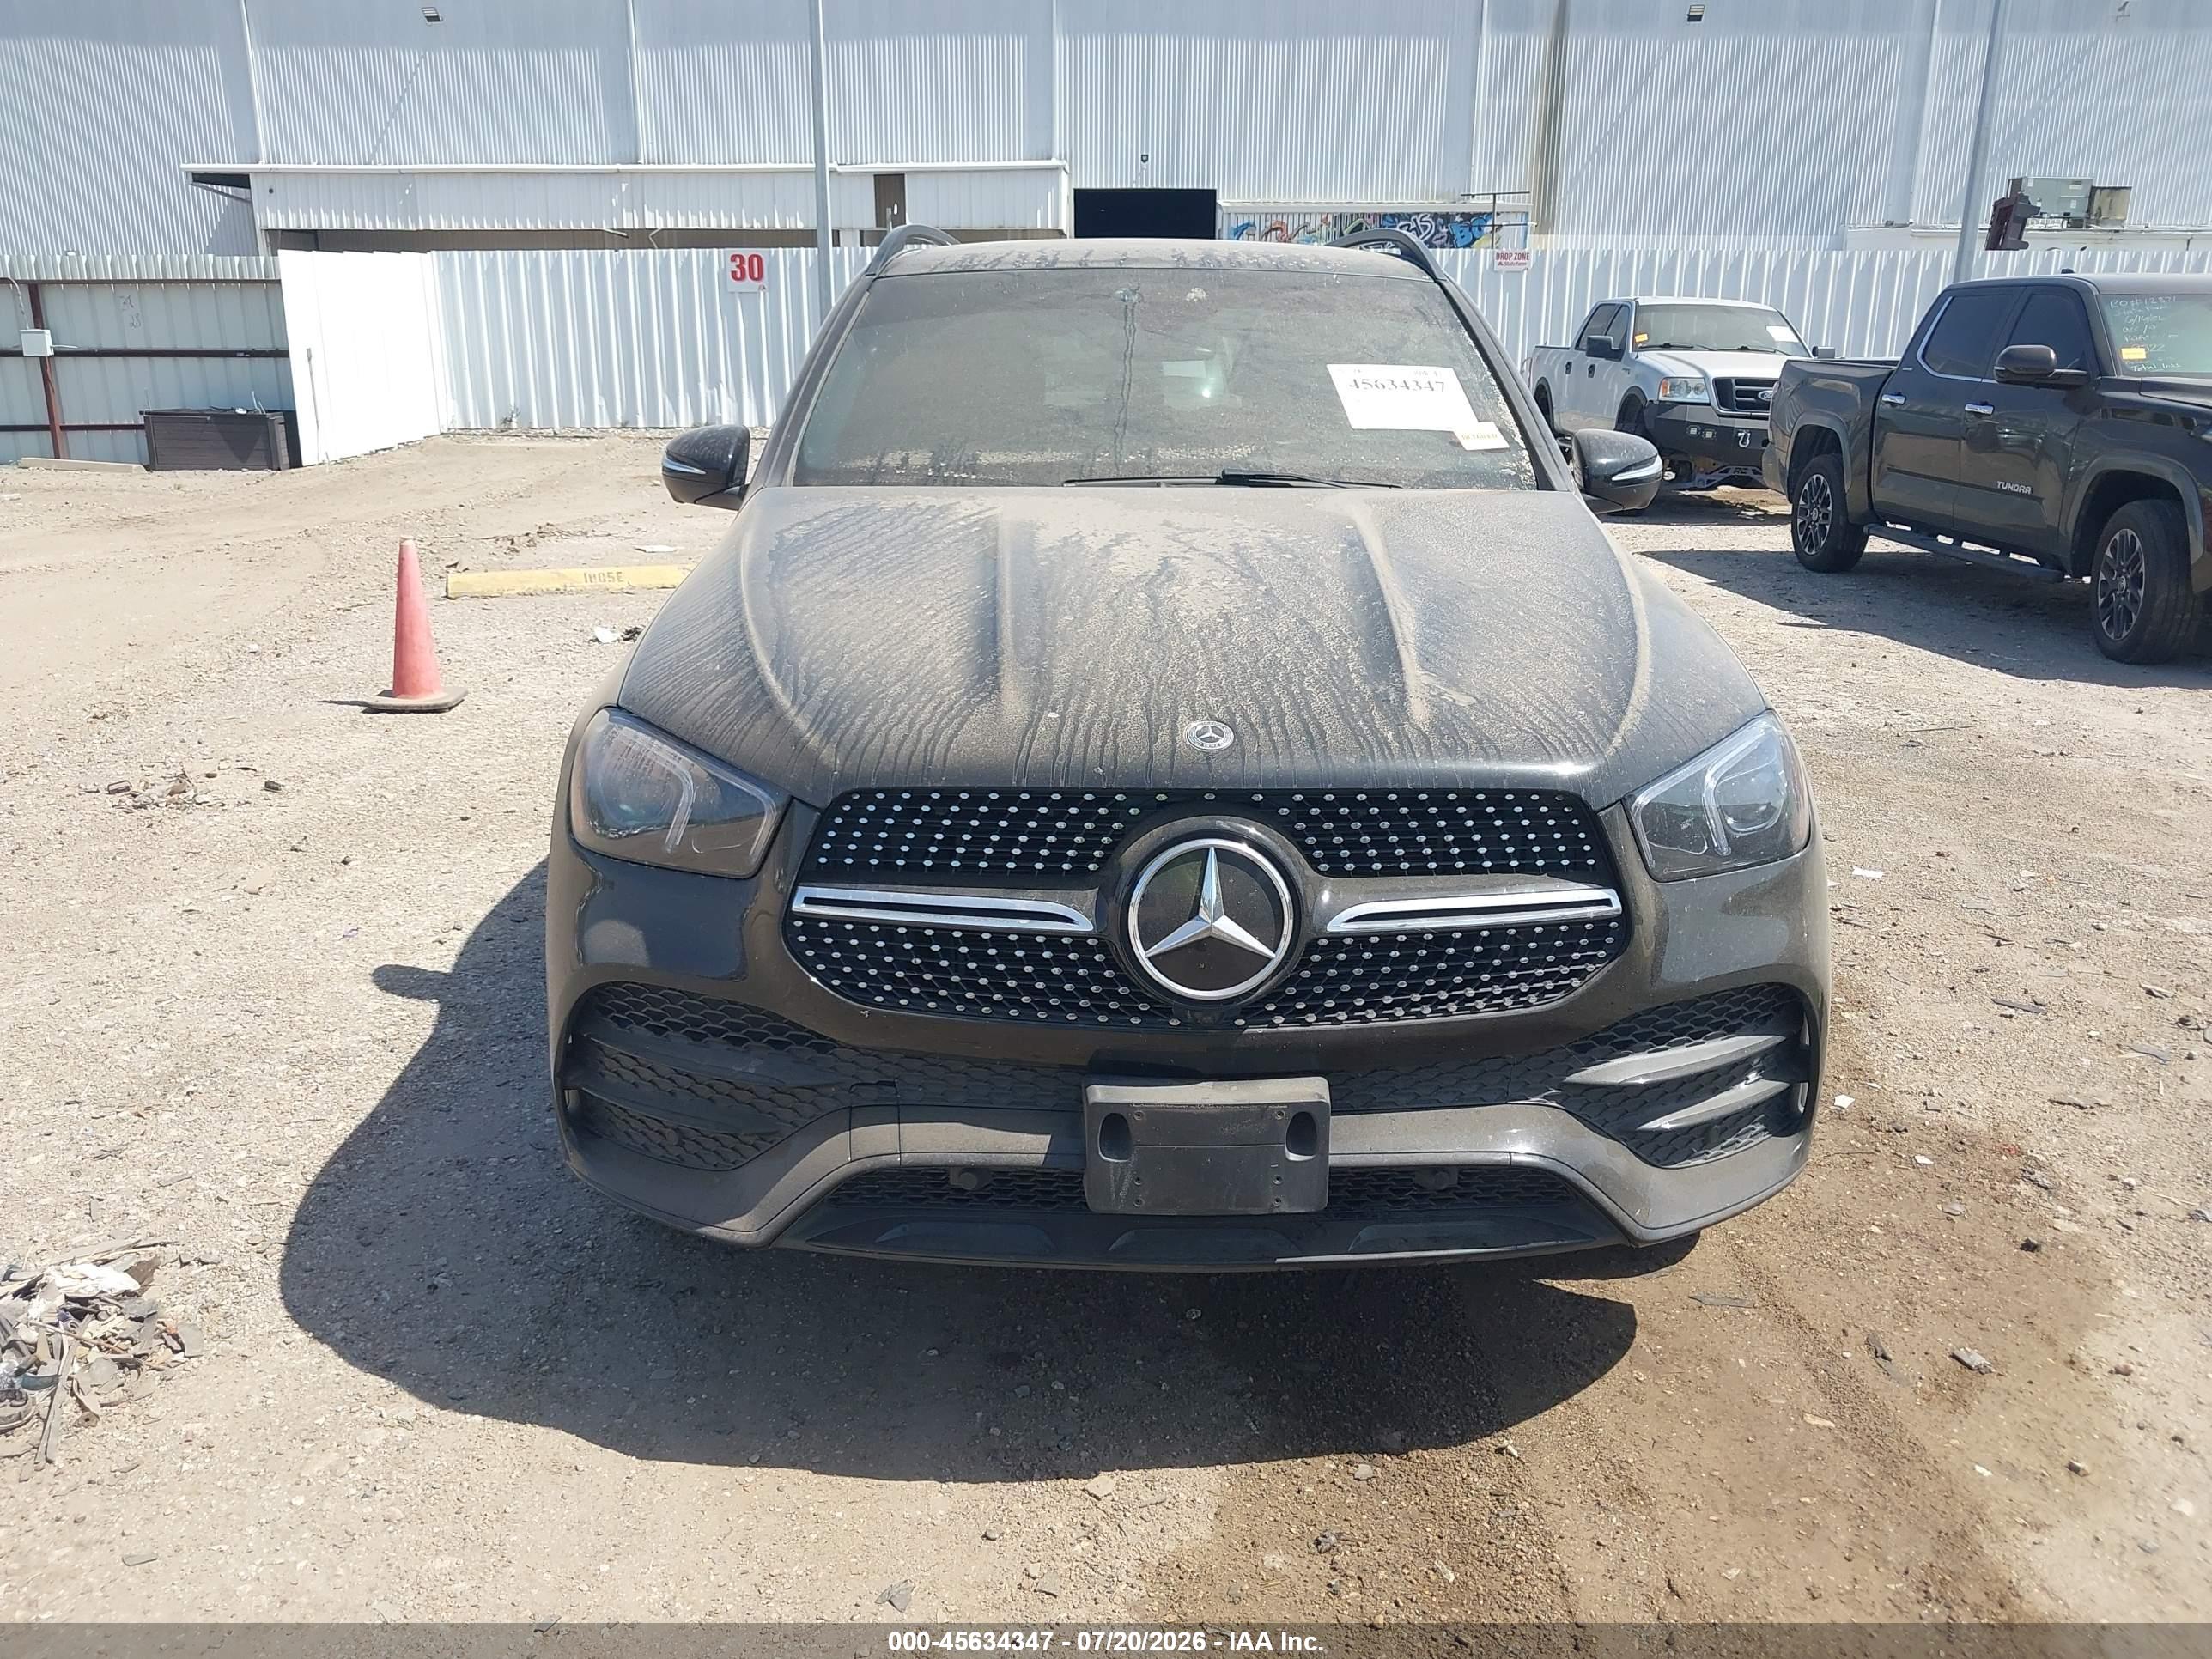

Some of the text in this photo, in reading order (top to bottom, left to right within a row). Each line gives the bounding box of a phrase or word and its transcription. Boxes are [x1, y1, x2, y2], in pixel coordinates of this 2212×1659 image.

[1496, 252, 1530, 261] DROP ZONE
[730, 253, 763, 282] 30
[1349, 378, 1444, 392] 45634347
[1997, 481, 2031, 495] TUNDRA
